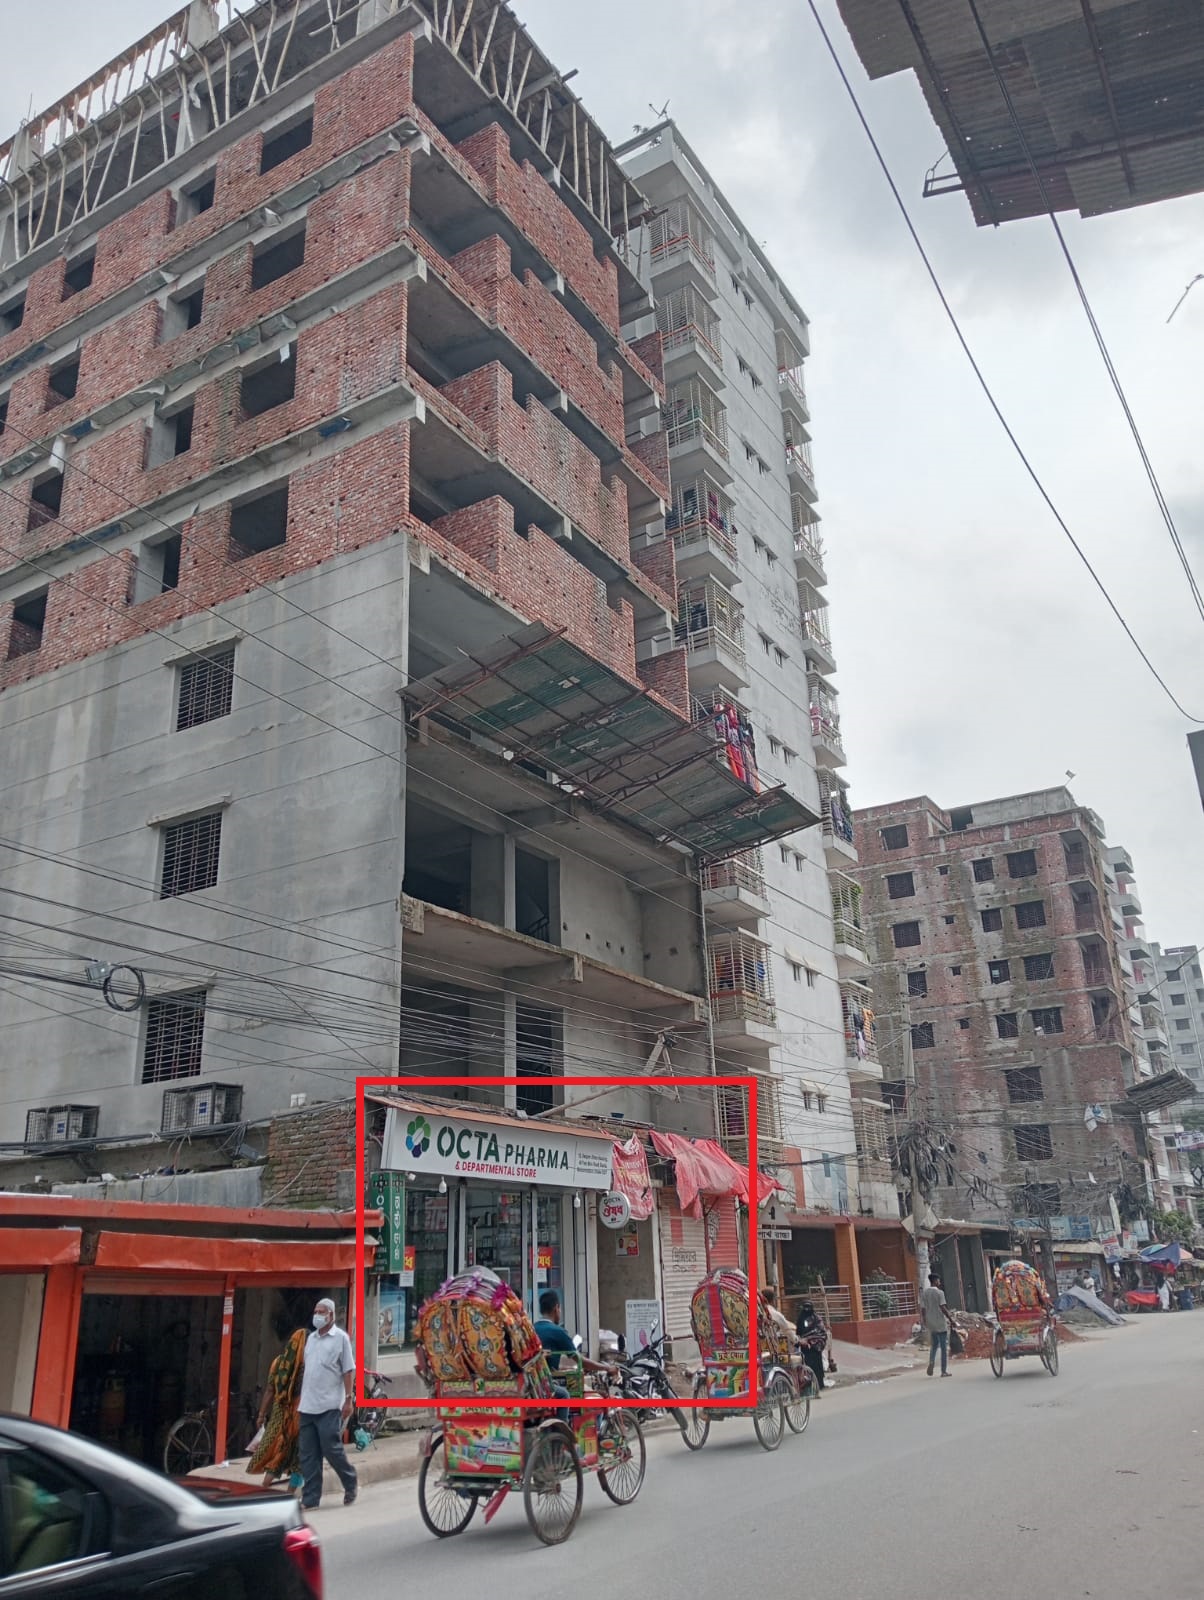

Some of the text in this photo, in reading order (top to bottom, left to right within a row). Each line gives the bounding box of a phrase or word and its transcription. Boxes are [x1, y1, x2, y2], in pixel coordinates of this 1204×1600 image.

[437, 1126, 569, 1170] OCTA PHARMA
[455, 1161, 537, 1178] & DEPARTMENTAL STORE
